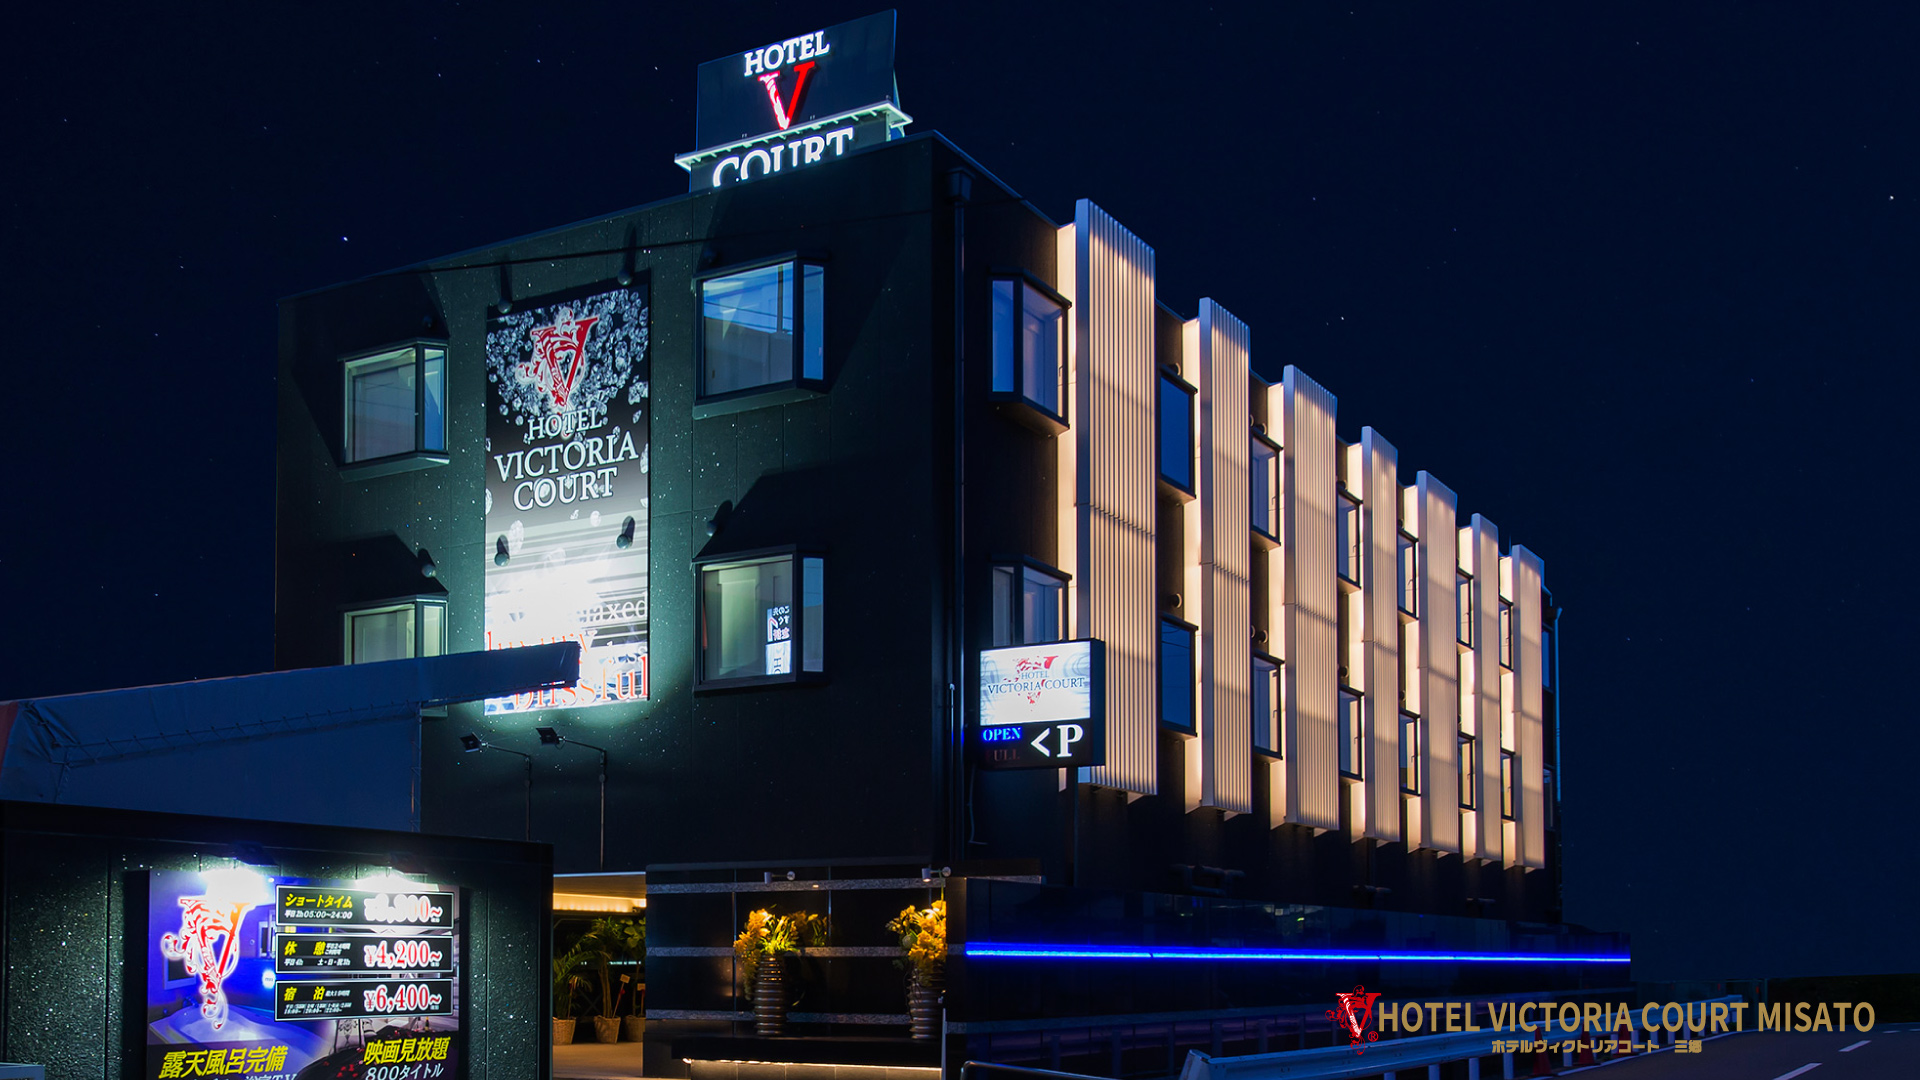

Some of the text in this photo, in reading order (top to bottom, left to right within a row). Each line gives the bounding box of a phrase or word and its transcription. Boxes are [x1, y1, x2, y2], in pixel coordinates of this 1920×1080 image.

[744, 30, 830, 77] HOTEL
[757, 61, 815, 131] V
[712, 126, 854, 188] COURT
[527, 406, 603, 441] HOTEL
[493, 430, 639, 483] VICTORIA
[513, 466, 618, 512] COURT
[988, 677, 1086, 694] VICTORIA COURT
[1021, 670, 1050, 680] HOTEL
[982, 727, 1021, 741] OPEN
[1056, 723, 1084, 758] P
[285, 893, 353, 908] ショートタイム
[158, 1045, 289, 1079] 露天風呂完備
[363, 1036, 451, 1065] 映画見放題
